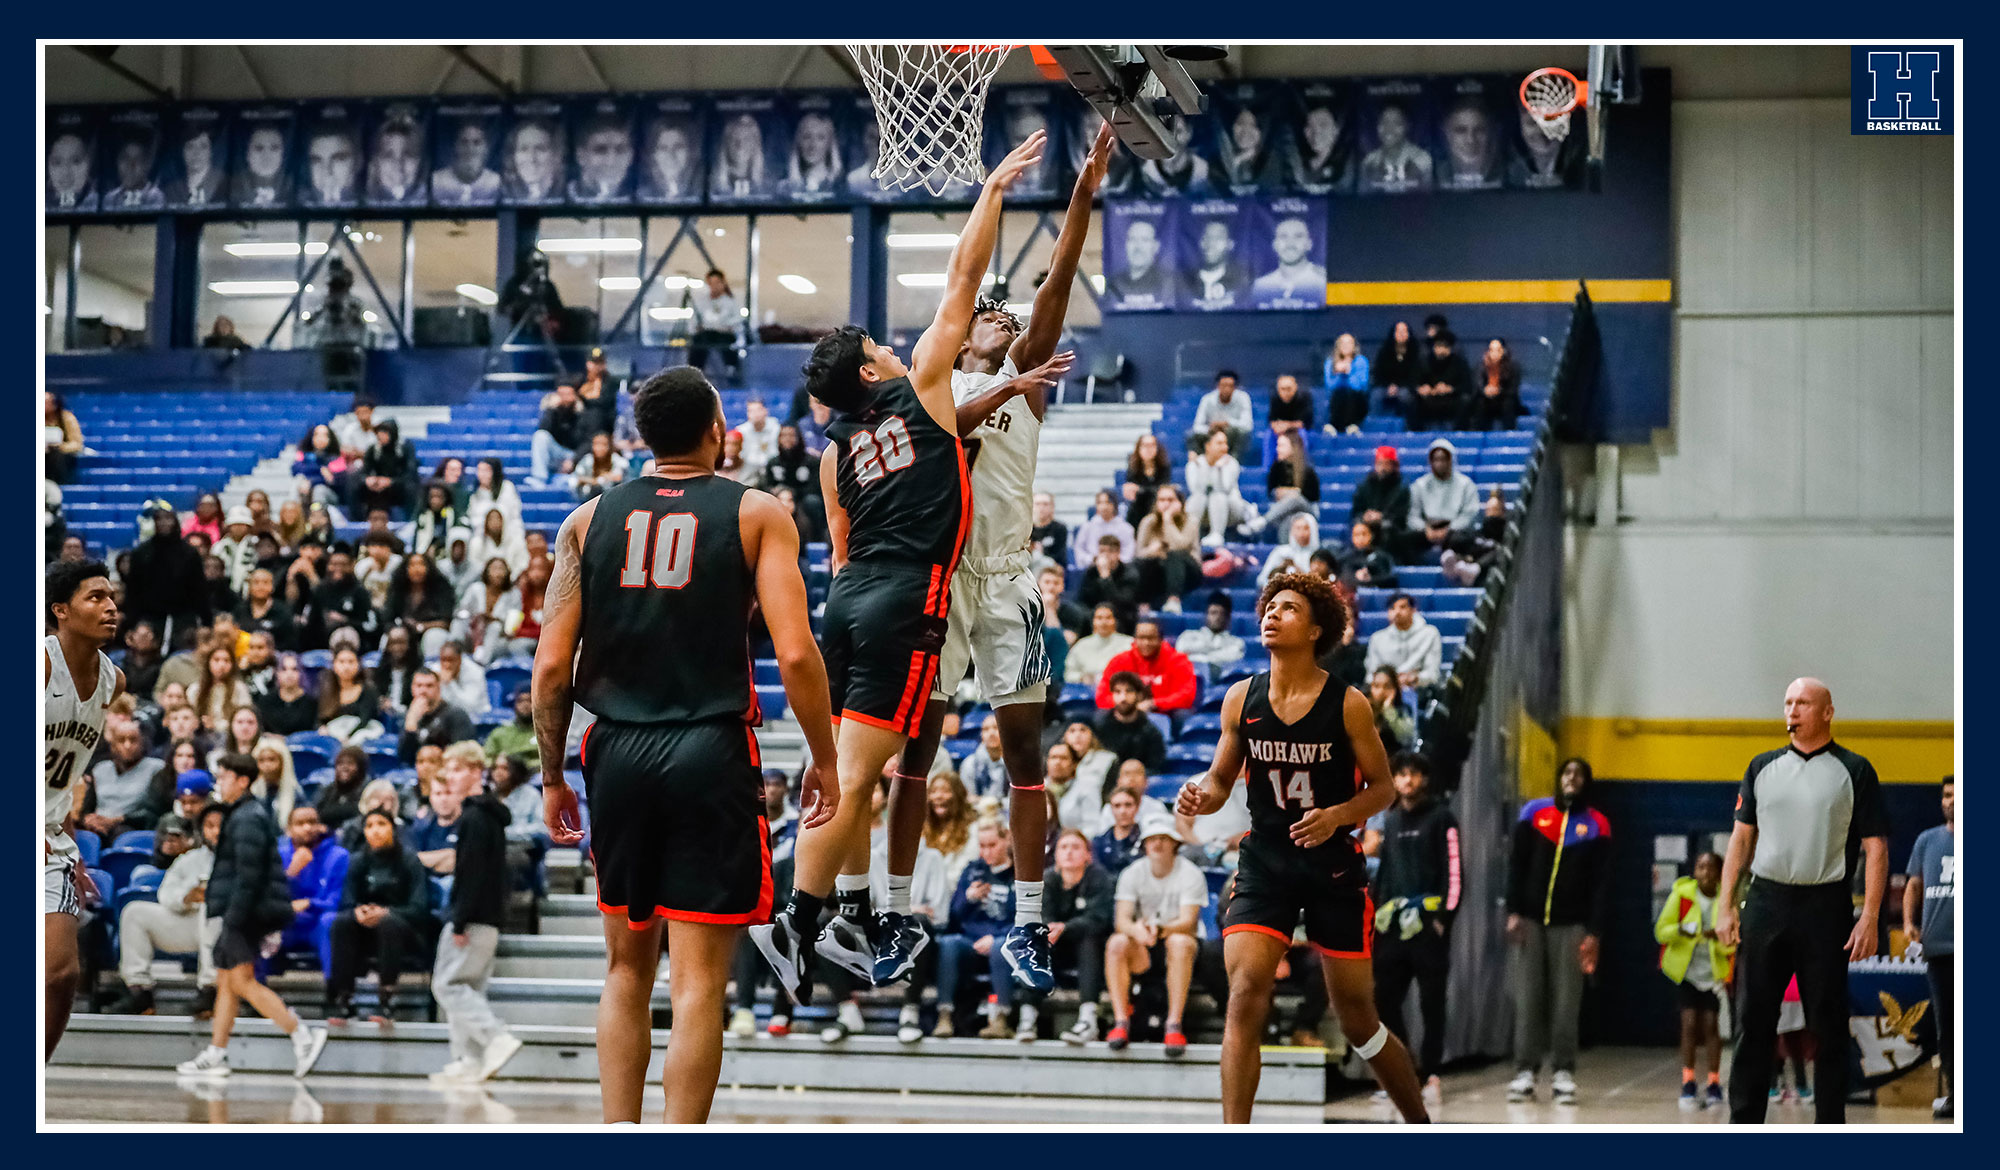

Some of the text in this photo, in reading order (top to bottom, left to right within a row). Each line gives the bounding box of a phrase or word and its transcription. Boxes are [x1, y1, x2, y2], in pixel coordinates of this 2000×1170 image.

[849, 415, 916, 488] 20
[620, 509, 699, 590] 10
[45, 720, 99, 750] HUMBER
[1248, 738, 1333, 764] MOHAWK
[1268, 769, 1315, 811] 14
